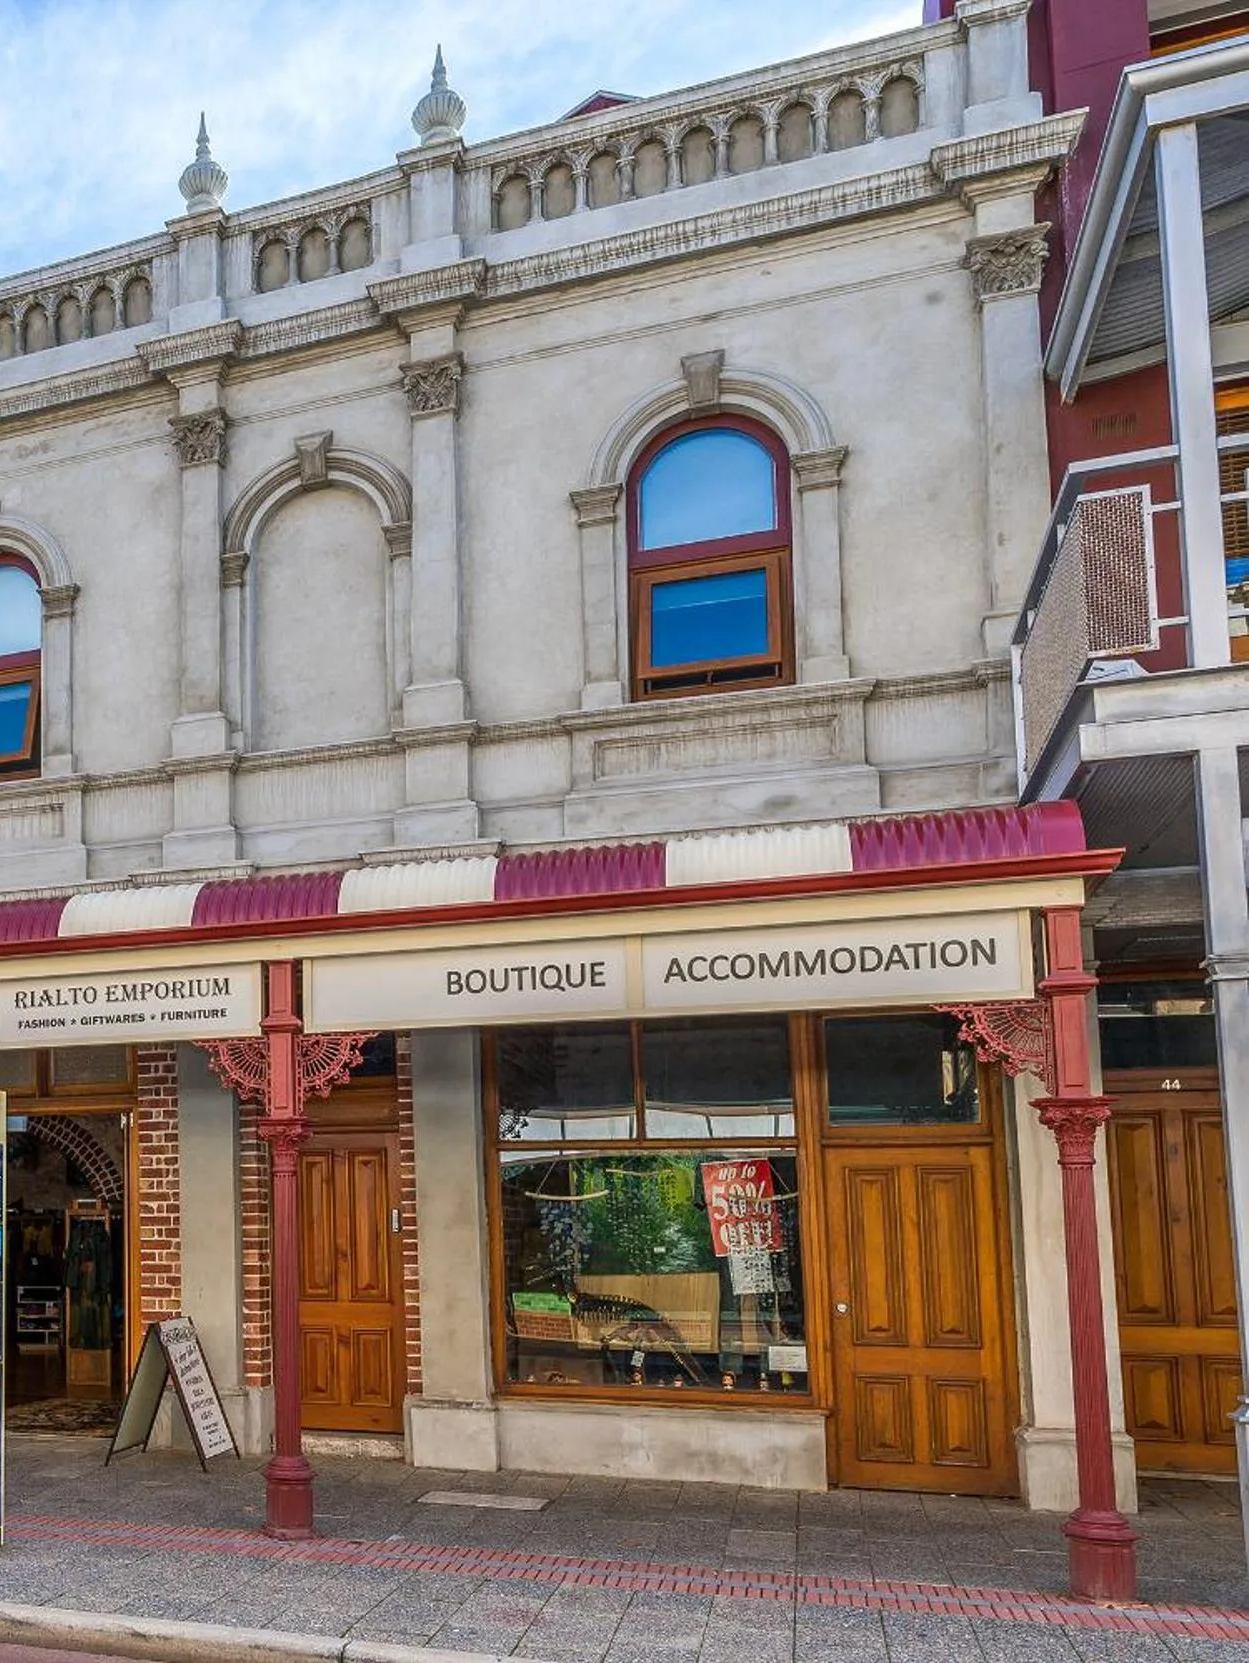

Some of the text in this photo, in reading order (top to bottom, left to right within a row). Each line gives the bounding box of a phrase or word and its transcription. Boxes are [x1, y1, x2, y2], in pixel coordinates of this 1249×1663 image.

[446, 938, 997, 995] BOUTIQUE ACCOMMODATION
[14, 977, 232, 1009] RIALTO EMPORIUM
[18, 1008, 228, 1029] FASHION GIFTWARES FURNITURE
[1161, 1079, 1181, 1090] 44
